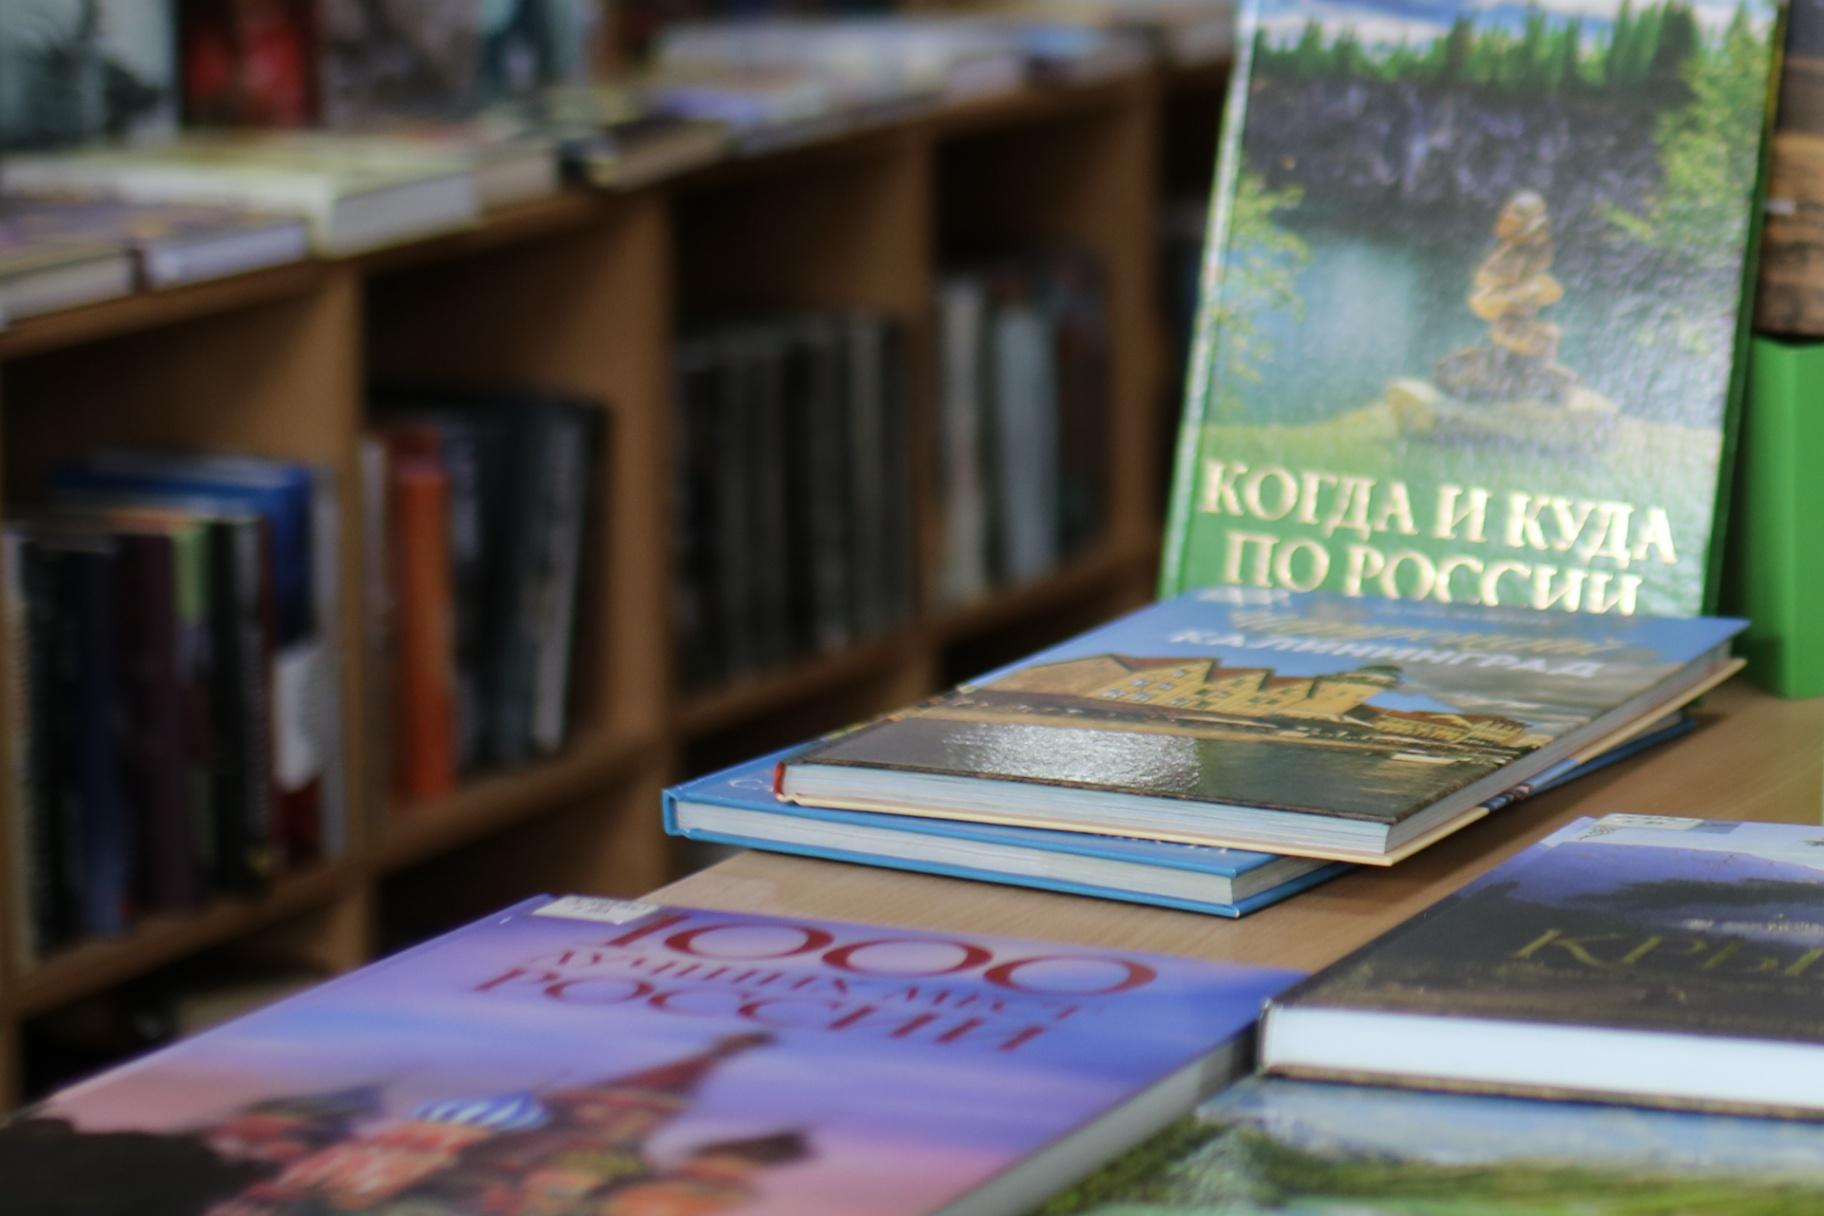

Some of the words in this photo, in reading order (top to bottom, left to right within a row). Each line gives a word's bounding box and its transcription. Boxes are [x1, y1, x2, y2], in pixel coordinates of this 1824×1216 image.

[1200, 458, 1419, 540] КОГДА
[1433, 483, 1494, 544] И
[1506, 491, 1677, 567] КУДА
[1223, 530, 1331, 593] ПО
[1343, 543, 1643, 616] РОССИИ
[605, 915, 1158, 997] 1000
[476, 967, 1046, 1052] РОССИИ
